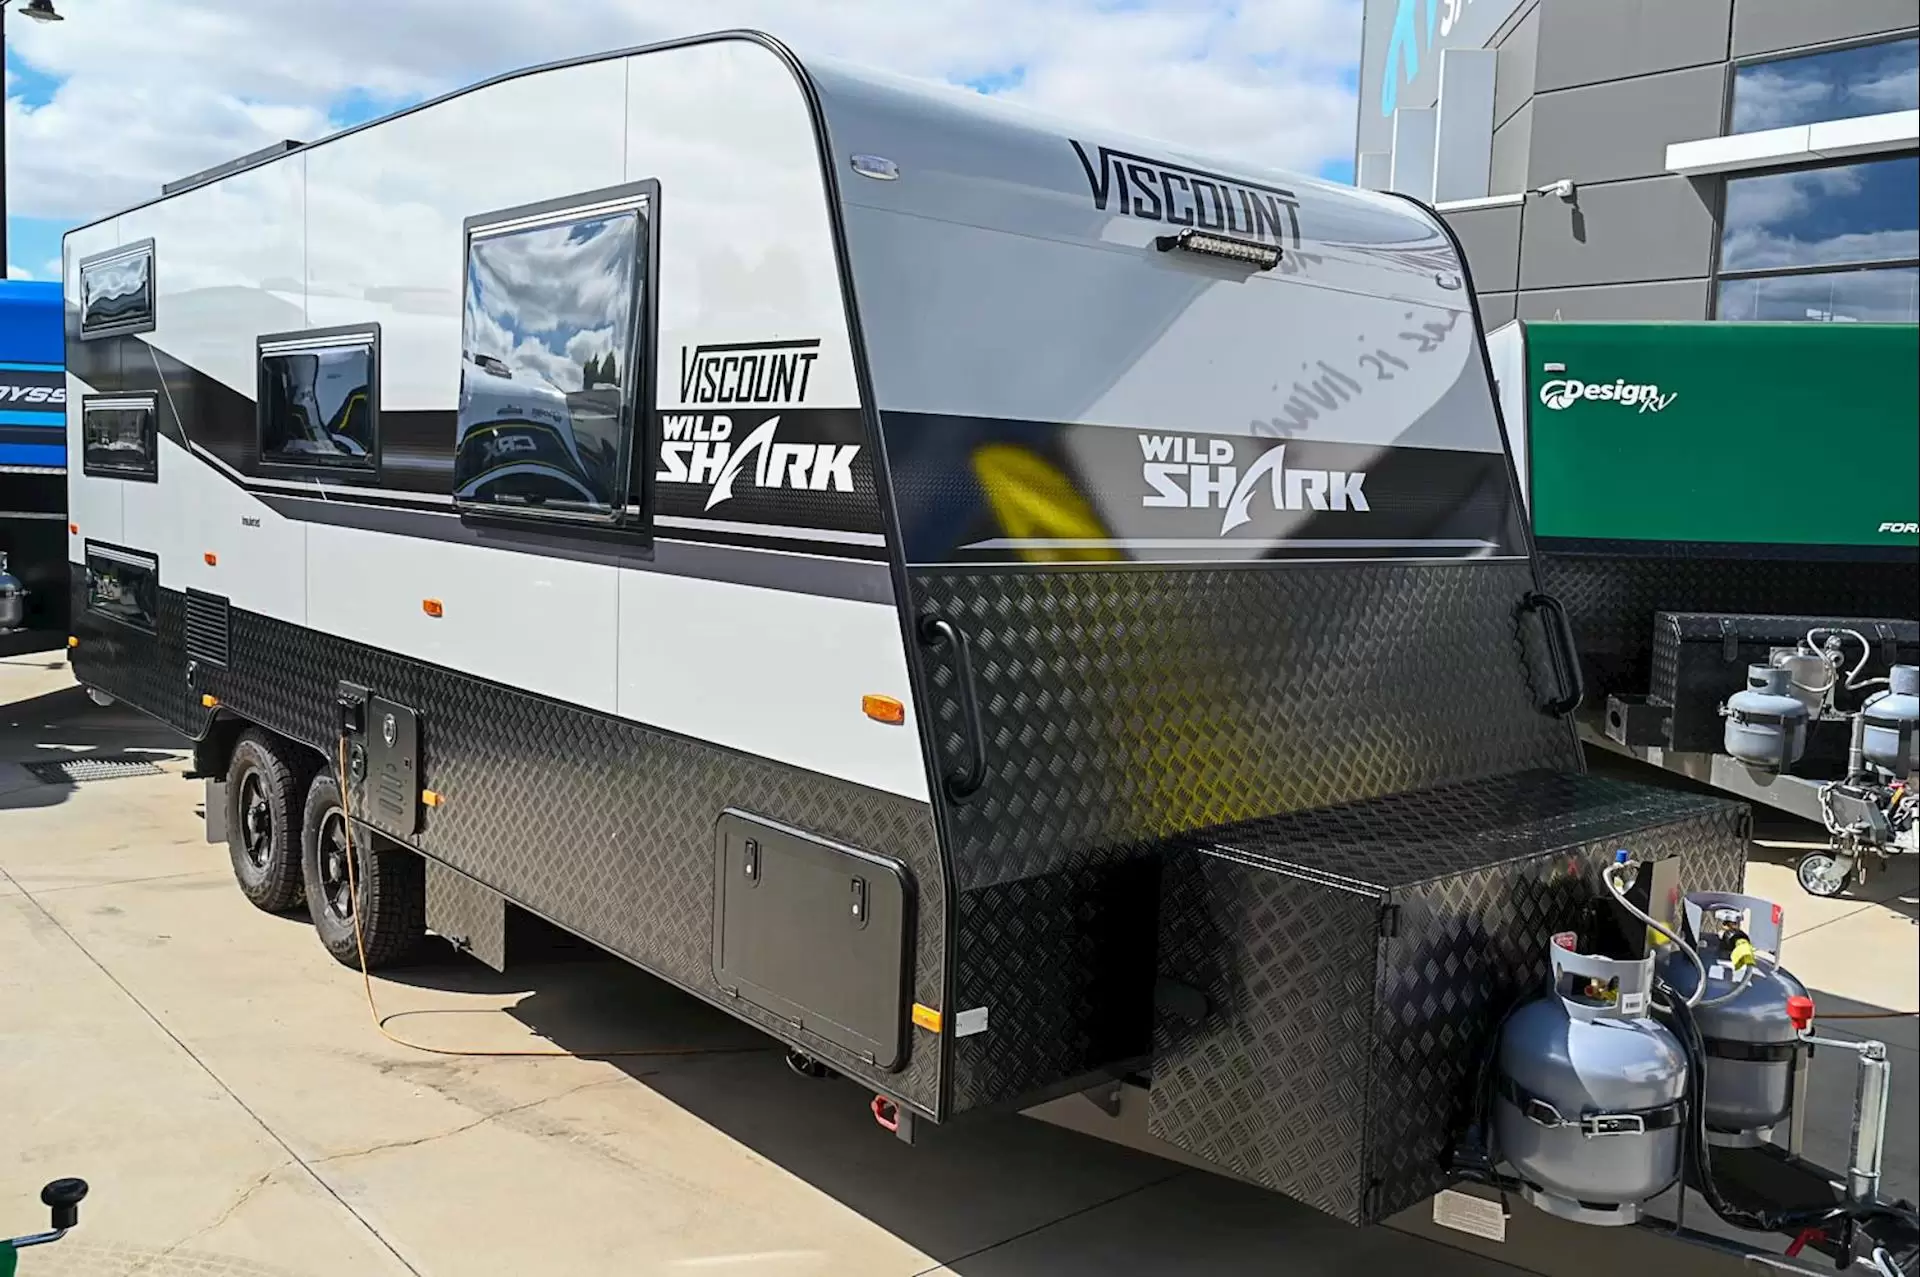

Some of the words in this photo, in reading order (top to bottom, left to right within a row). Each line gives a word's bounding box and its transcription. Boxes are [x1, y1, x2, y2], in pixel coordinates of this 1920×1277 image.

[1068, 138, 1301, 250] VISCOUNT
[681, 338, 821, 404] VISCOUNT
[1563, 378, 1658, 405] Design
[1639, 392, 1678, 414] RV
[662, 415, 733, 441] WILD
[1138, 434, 1236, 465] WILD
[655, 415, 862, 512] SHARK
[1142, 443, 1371, 537] SHARK
[1878, 522, 1919, 534] FOR
